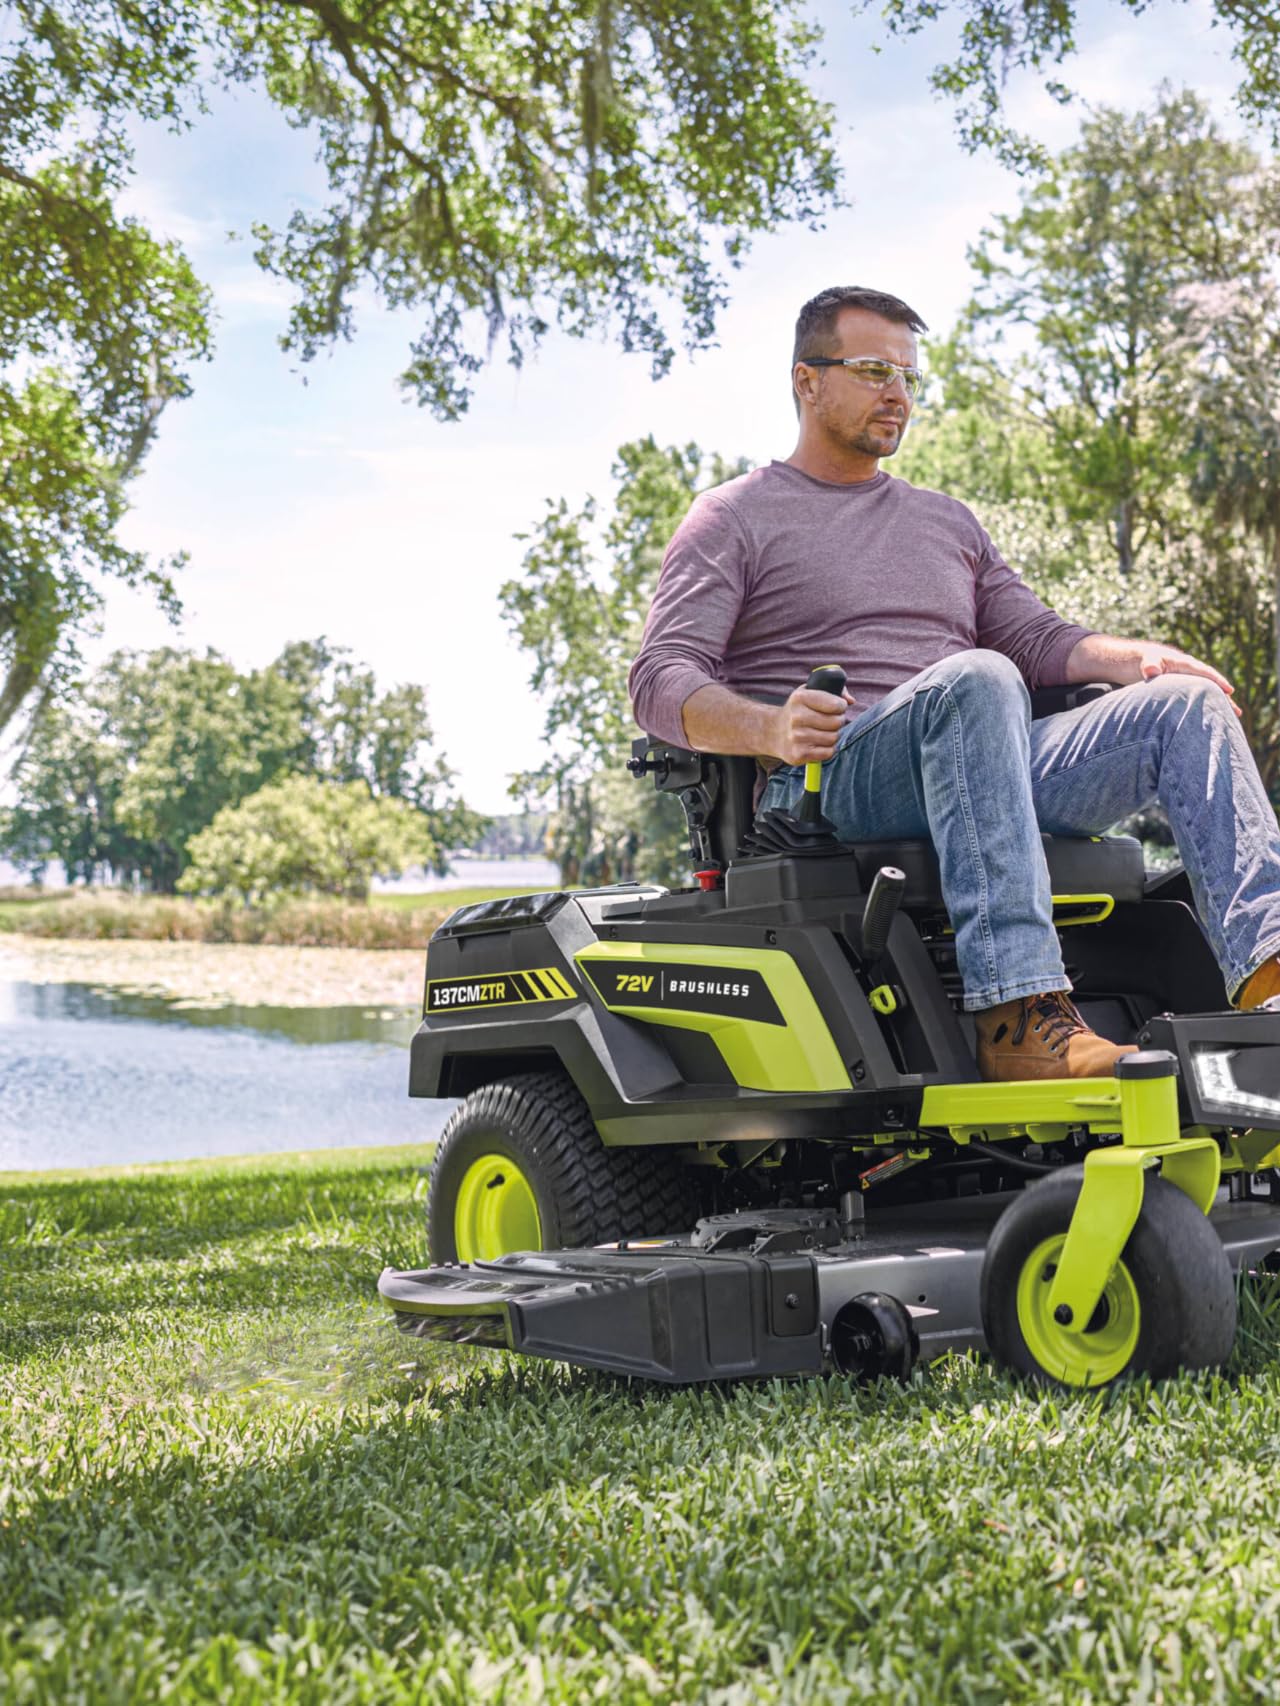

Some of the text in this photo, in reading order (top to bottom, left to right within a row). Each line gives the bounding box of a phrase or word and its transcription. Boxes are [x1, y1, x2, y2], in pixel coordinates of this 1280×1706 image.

[433, 982, 506, 1006] 137CMZTR
[616, 974, 750, 997] 72V BRUSHLESS
